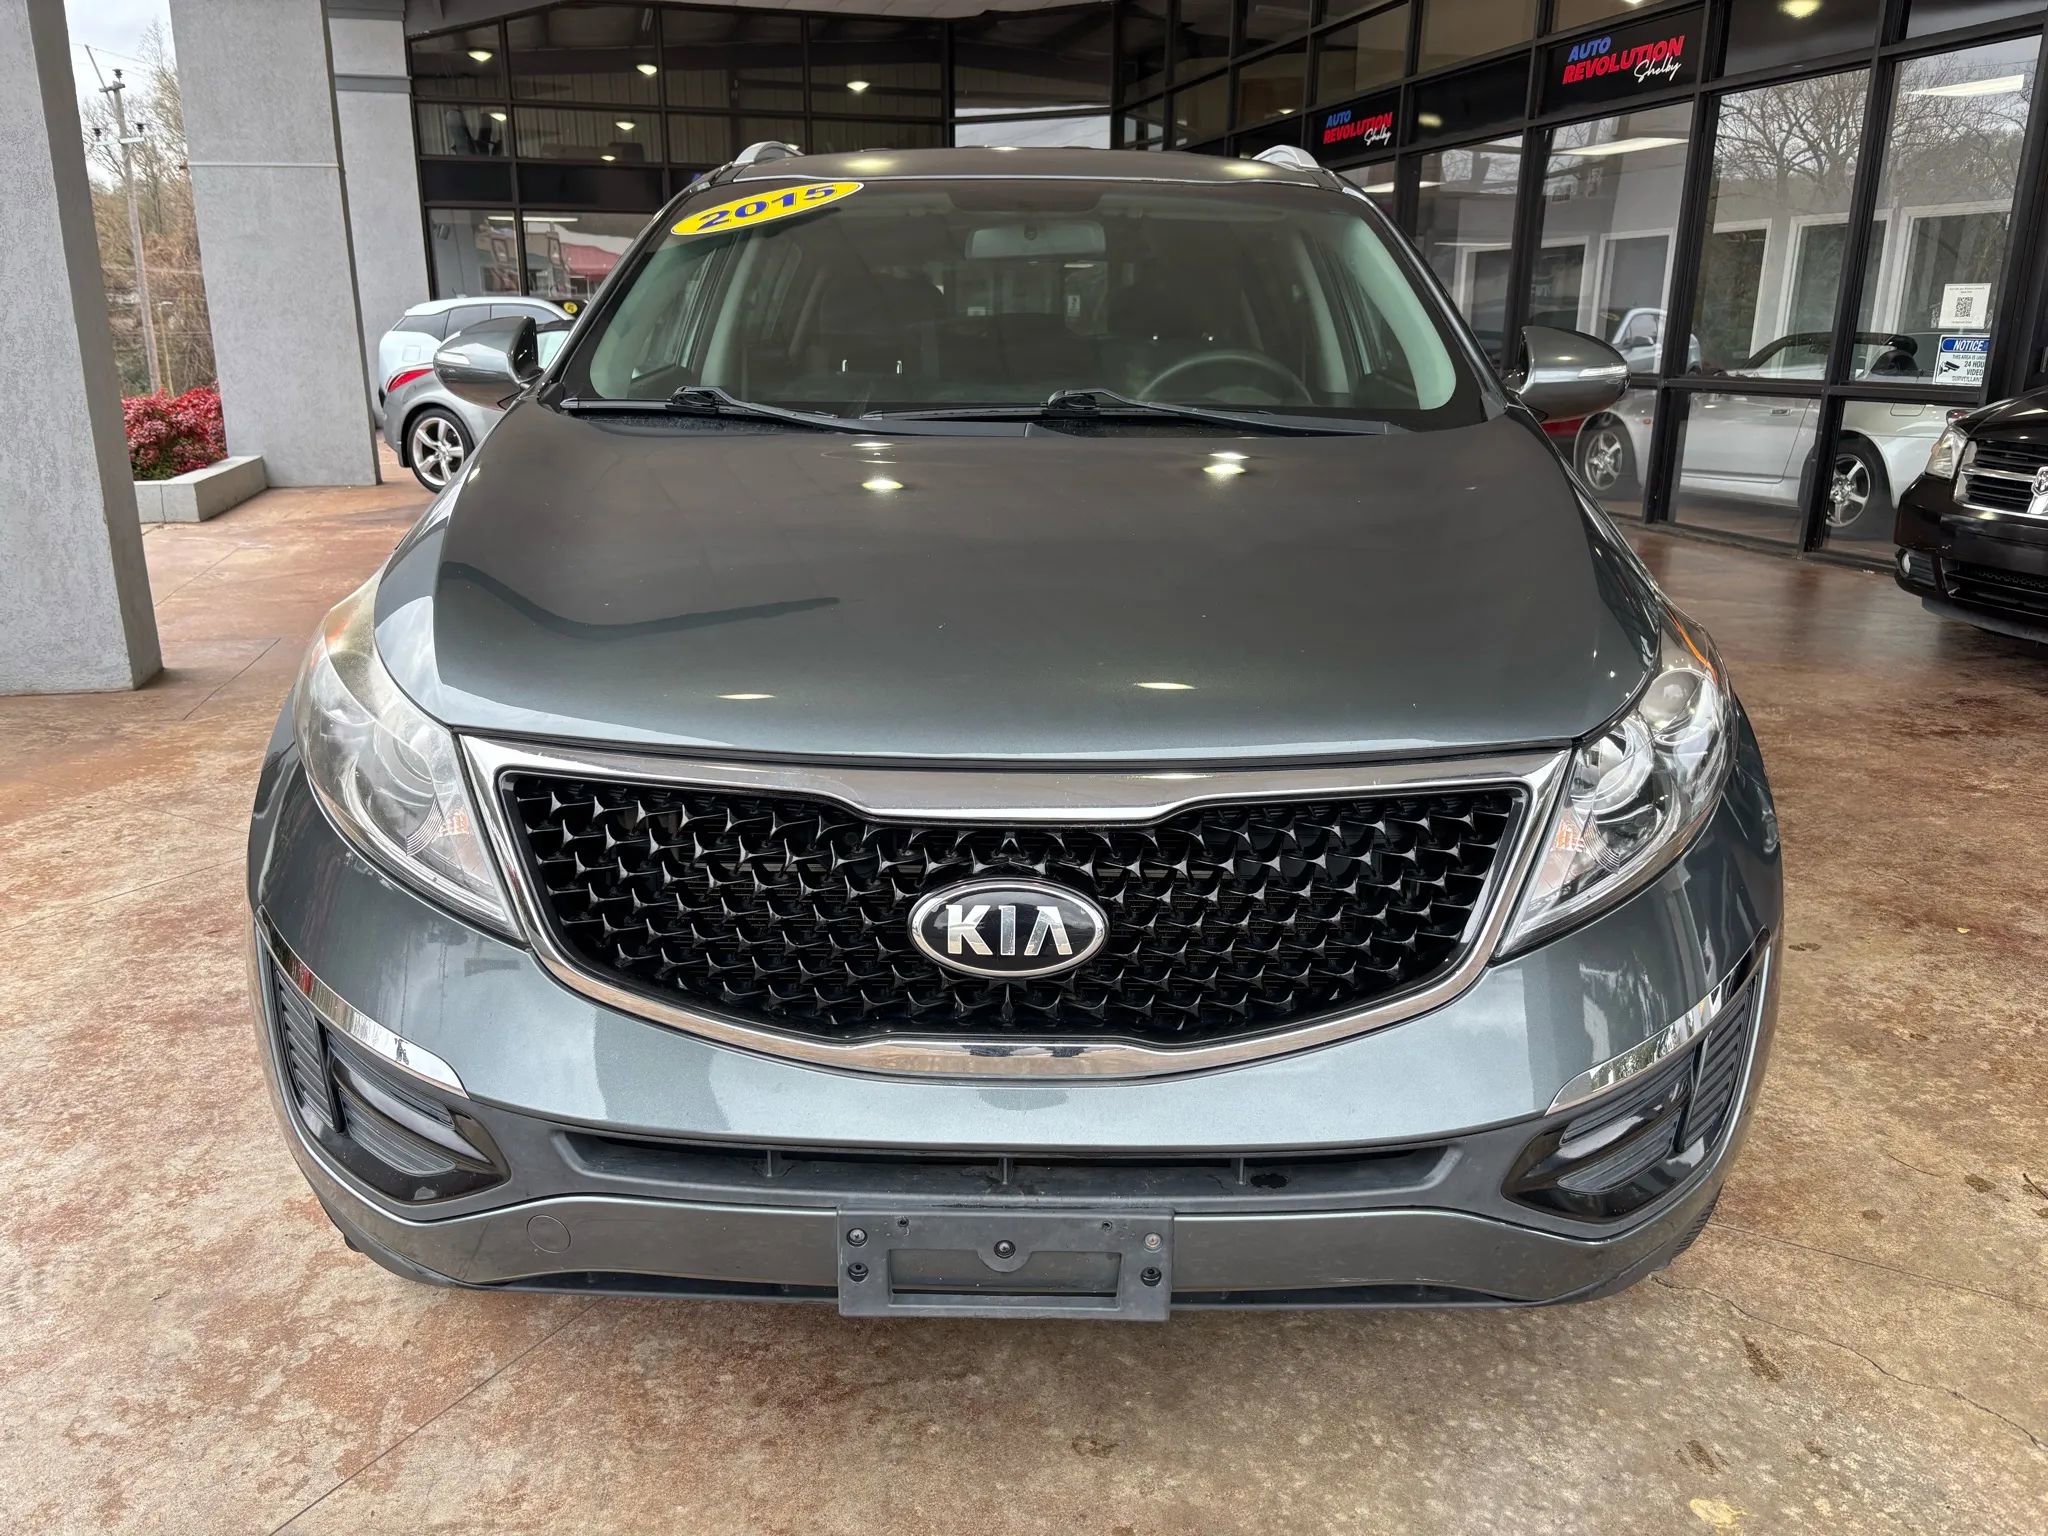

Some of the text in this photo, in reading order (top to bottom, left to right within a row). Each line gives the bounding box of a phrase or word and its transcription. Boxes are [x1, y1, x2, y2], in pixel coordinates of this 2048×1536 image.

[1562, 35, 1685, 84] REVOLUTION
[1568, 36, 1612, 63] AUTO
[1634, 53, 1682, 83] Shelby
[1323, 112, 1393, 144] REVOLUTION
[1326, 110, 1352, 128] AUTO
[1364, 124, 1392, 146] Shelby
[697, 184, 838, 231] 2015
[1952, 339, 1985, 351] NOTICE
[1964, 360, 1985, 368] 24 HOU
[1966, 368, 1984, 376] VIDEO
[1952, 375, 1983, 383] SURVEILLANC
[945, 904, 1073, 956] KIA
